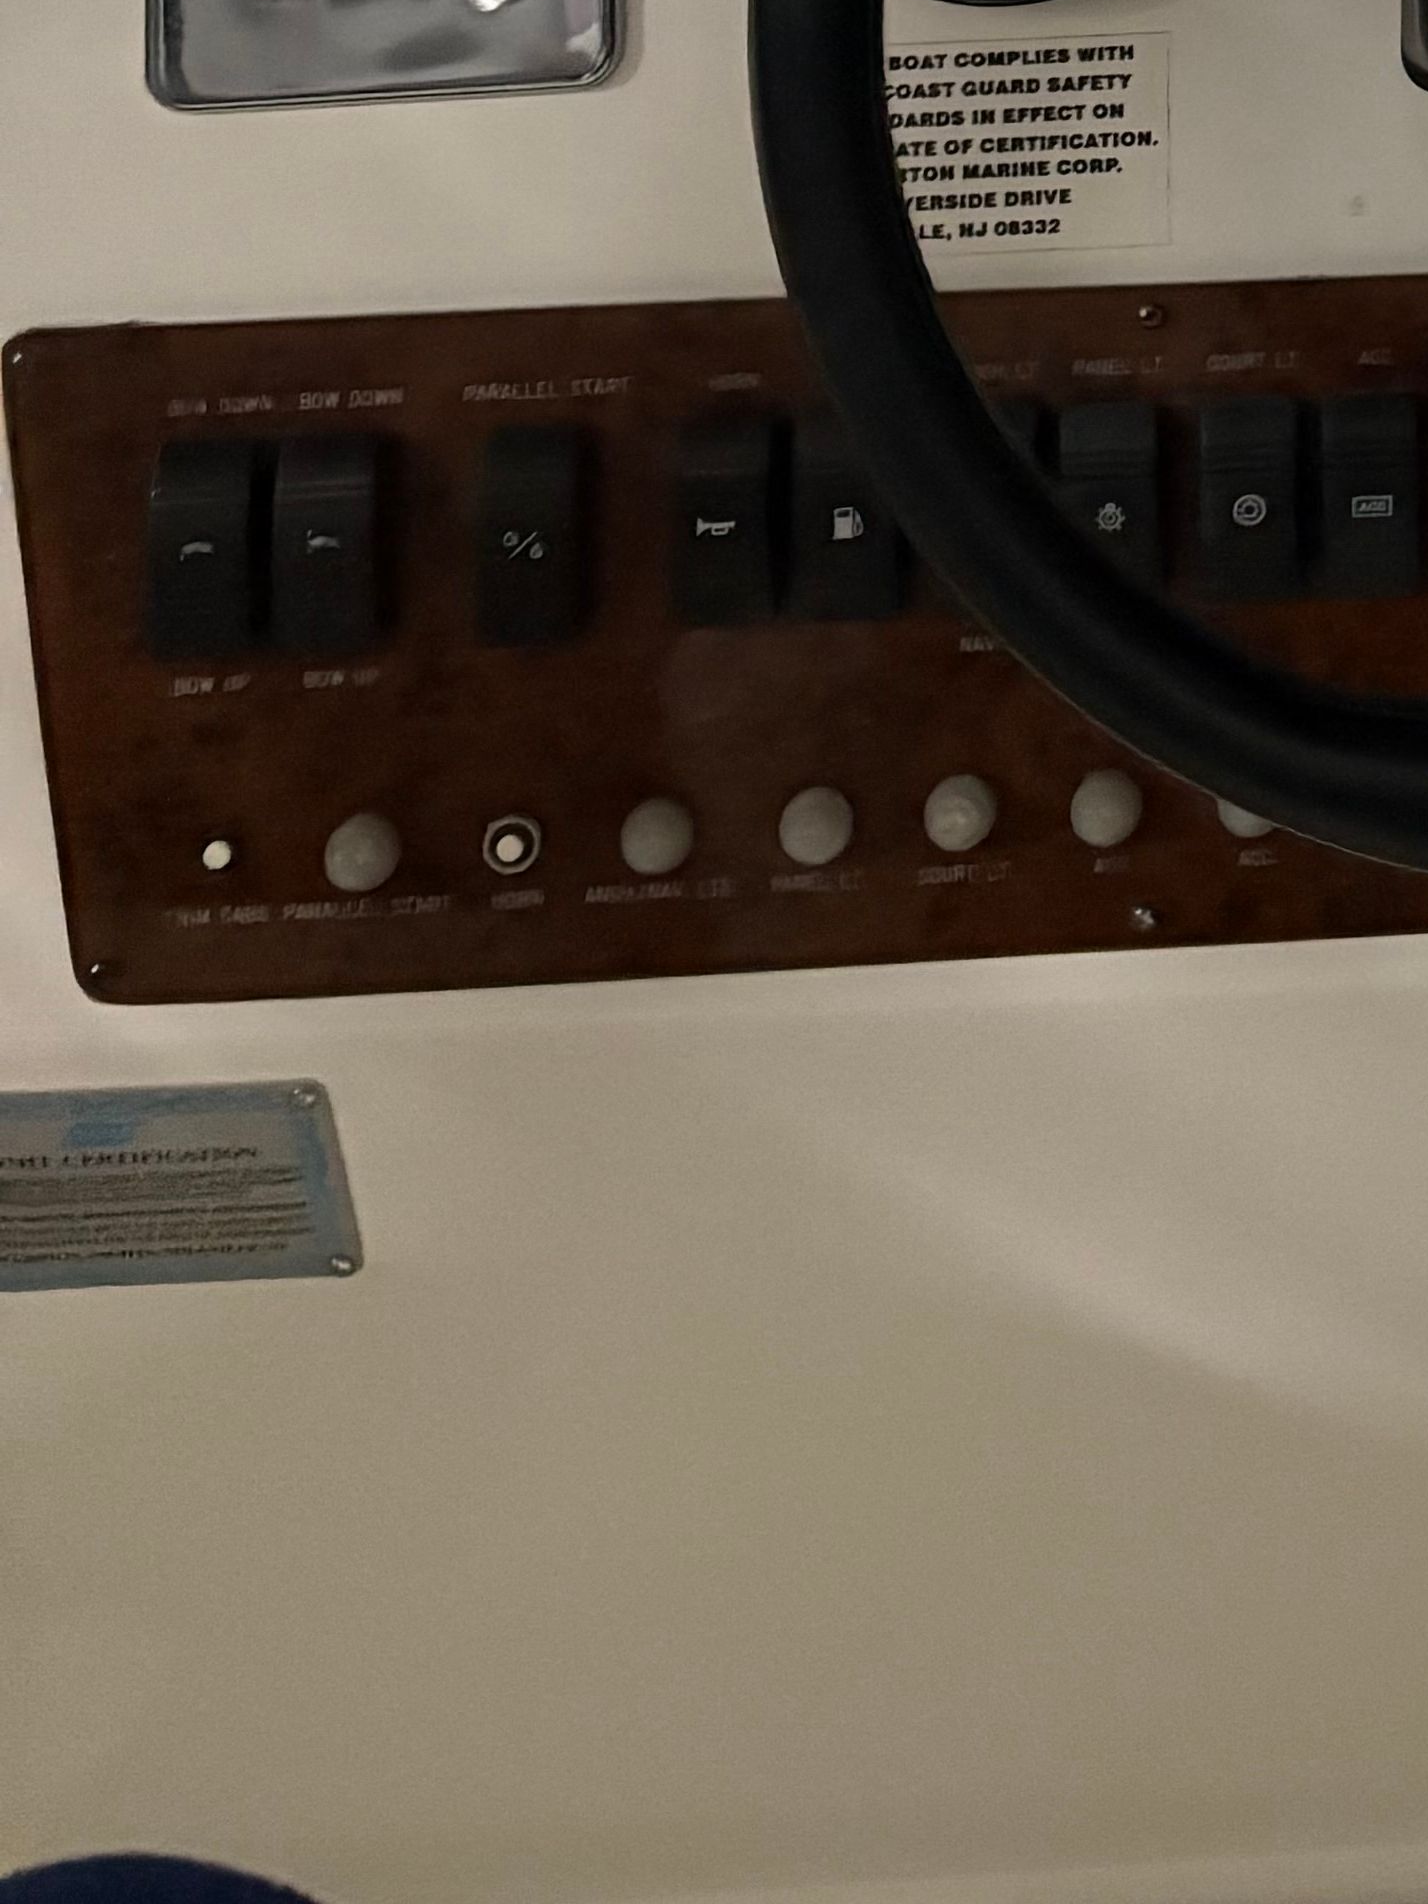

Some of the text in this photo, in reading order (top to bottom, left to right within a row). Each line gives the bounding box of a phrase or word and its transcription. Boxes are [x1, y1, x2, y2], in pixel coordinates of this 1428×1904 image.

[888, 45, 1135, 71] BOAT COMPLIES WITH
[961, 78, 1041, 96] GUARD
[1047, 74, 1133, 92] SAFETY
[889, 103, 1125, 129] DARDS IN EFFECT ON
[896, 131, 1160, 157] ATE OF CERTIFICATION.
[962, 163, 1051, 179] MARINE
[1056, 158, 1123, 176] CORP.
[1004, 188, 1073, 207] DRIVE
[959, 223, 988, 238] NJ
[993, 219, 1061, 236] 08332
